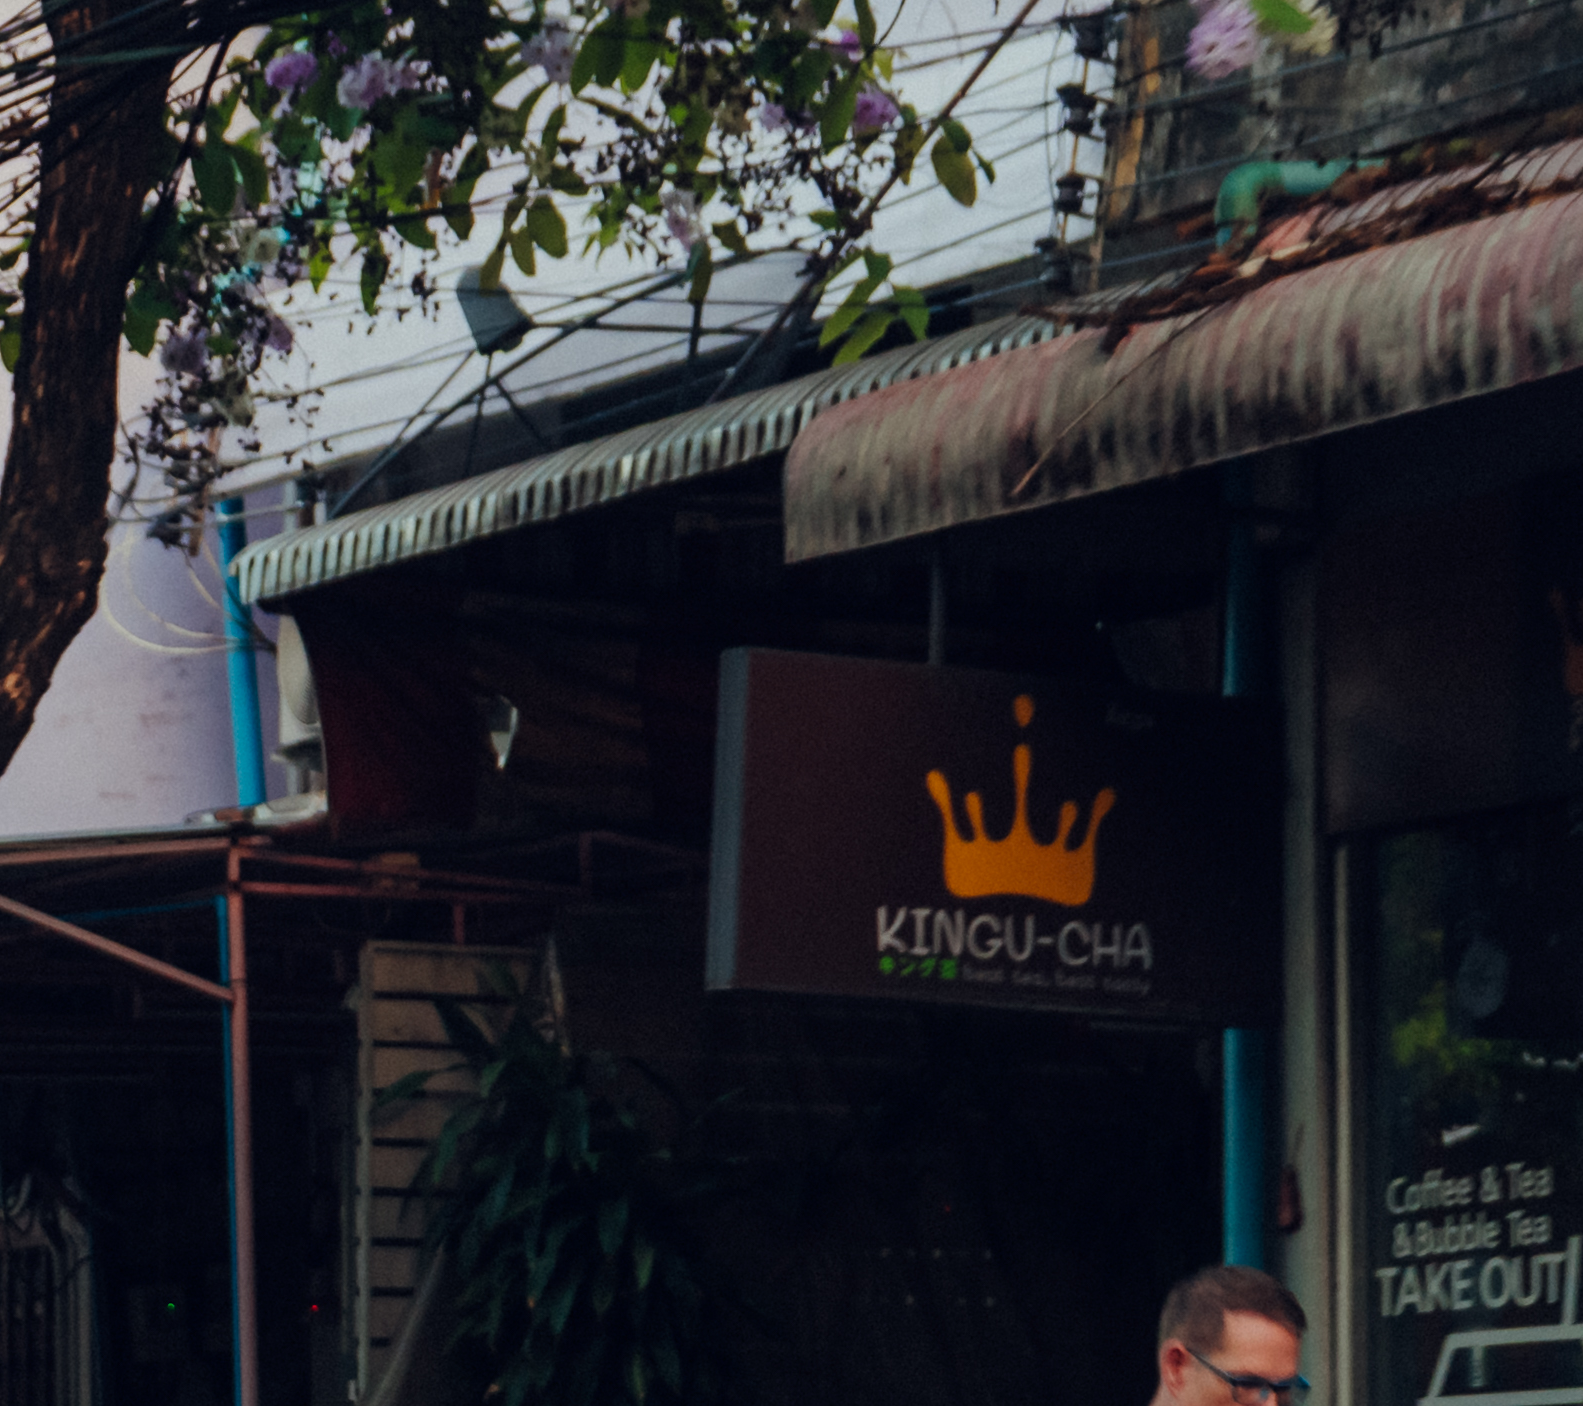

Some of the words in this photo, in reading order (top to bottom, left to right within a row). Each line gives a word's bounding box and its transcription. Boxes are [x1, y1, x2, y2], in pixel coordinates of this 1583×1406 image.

[876, 904, 1153, 970] KINGU-CHA
[1387, 1167, 1475, 1214] Coffee
[1479, 1164, 1504, 1203] &
[1504, 1160, 1554, 1200] Tea
[1505, 1208, 1553, 1248] Tea
[1375, 1257, 1475, 1317] TAKE
[1479, 1250, 1569, 1309] OUT
